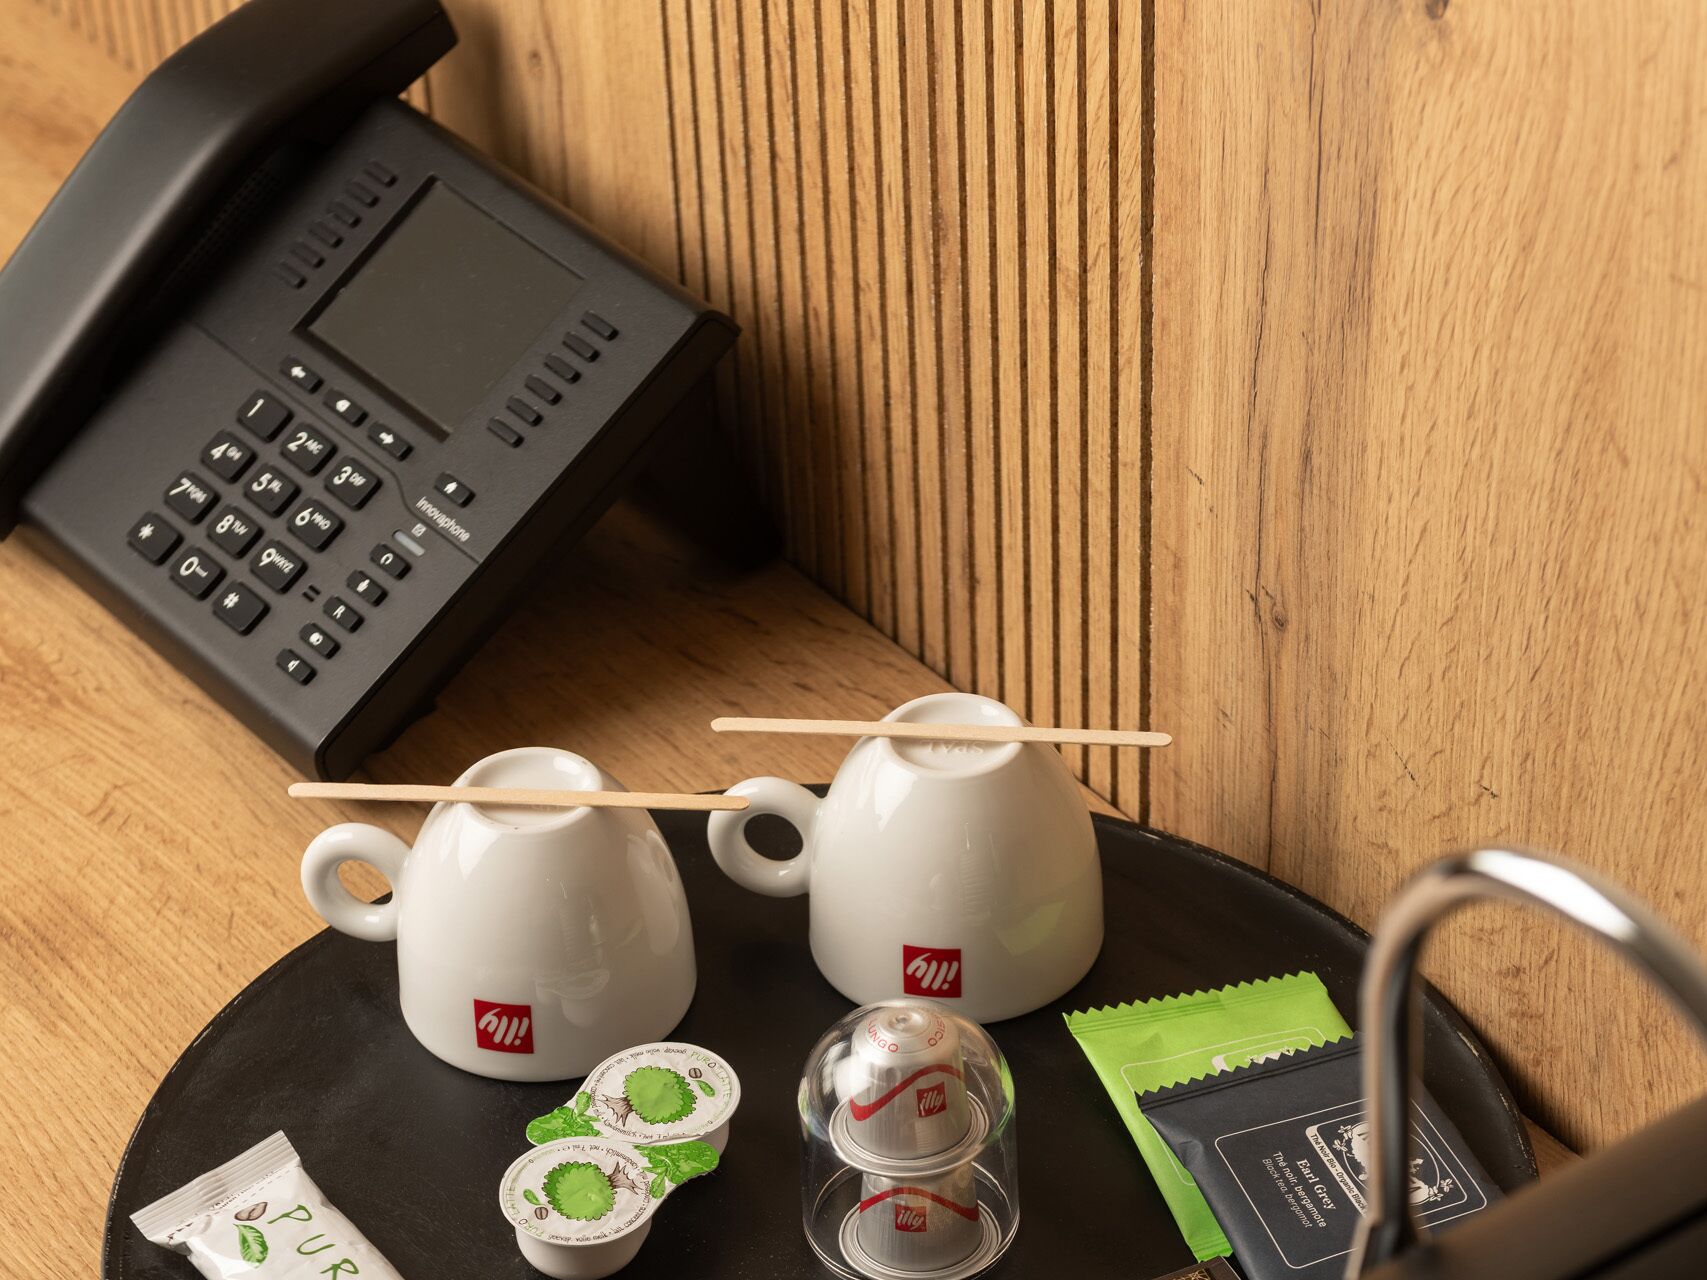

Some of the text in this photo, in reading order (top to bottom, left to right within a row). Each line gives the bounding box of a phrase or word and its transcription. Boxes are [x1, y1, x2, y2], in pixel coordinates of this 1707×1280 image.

[247, 398, 264, 417] 1
[210, 442, 230, 460] 4
[287, 432, 324, 455] 2 ABC
[169, 477, 192, 496] 7
[251, 473, 273, 492] 5
[333, 466, 367, 487] 3 DEF
[215, 514, 249, 536] 8 TUV
[295, 507, 331, 530] 6 MNO
[179, 556, 200, 577] 0
[259, 547, 295, 574] 9 WXYZ
[332, 605, 346, 620] R
[906, 952, 959, 991] illy
[478, 1007, 529, 1046] illy
[690, 1051, 717, 1069] PURO
[920, 1089, 945, 1113] illy
[1310, 1133, 1321, 1146] Thé
[1318, 1145, 1330, 1158] Noir
[1326, 1158, 1337, 1169] Bio
[1336, 1170, 1355, 1195] Organic
[1262, 1158, 1280, 1179] Black
[1285, 1194, 1313, 1228] bergamot
[1273, 1151, 1327, 1228] Thé noir, bergamote
[1296, 1159, 1337, 1210] Earl Grey
[518, 1218, 545, 1238] PURO
[897, 1206, 927, 1231] illy
